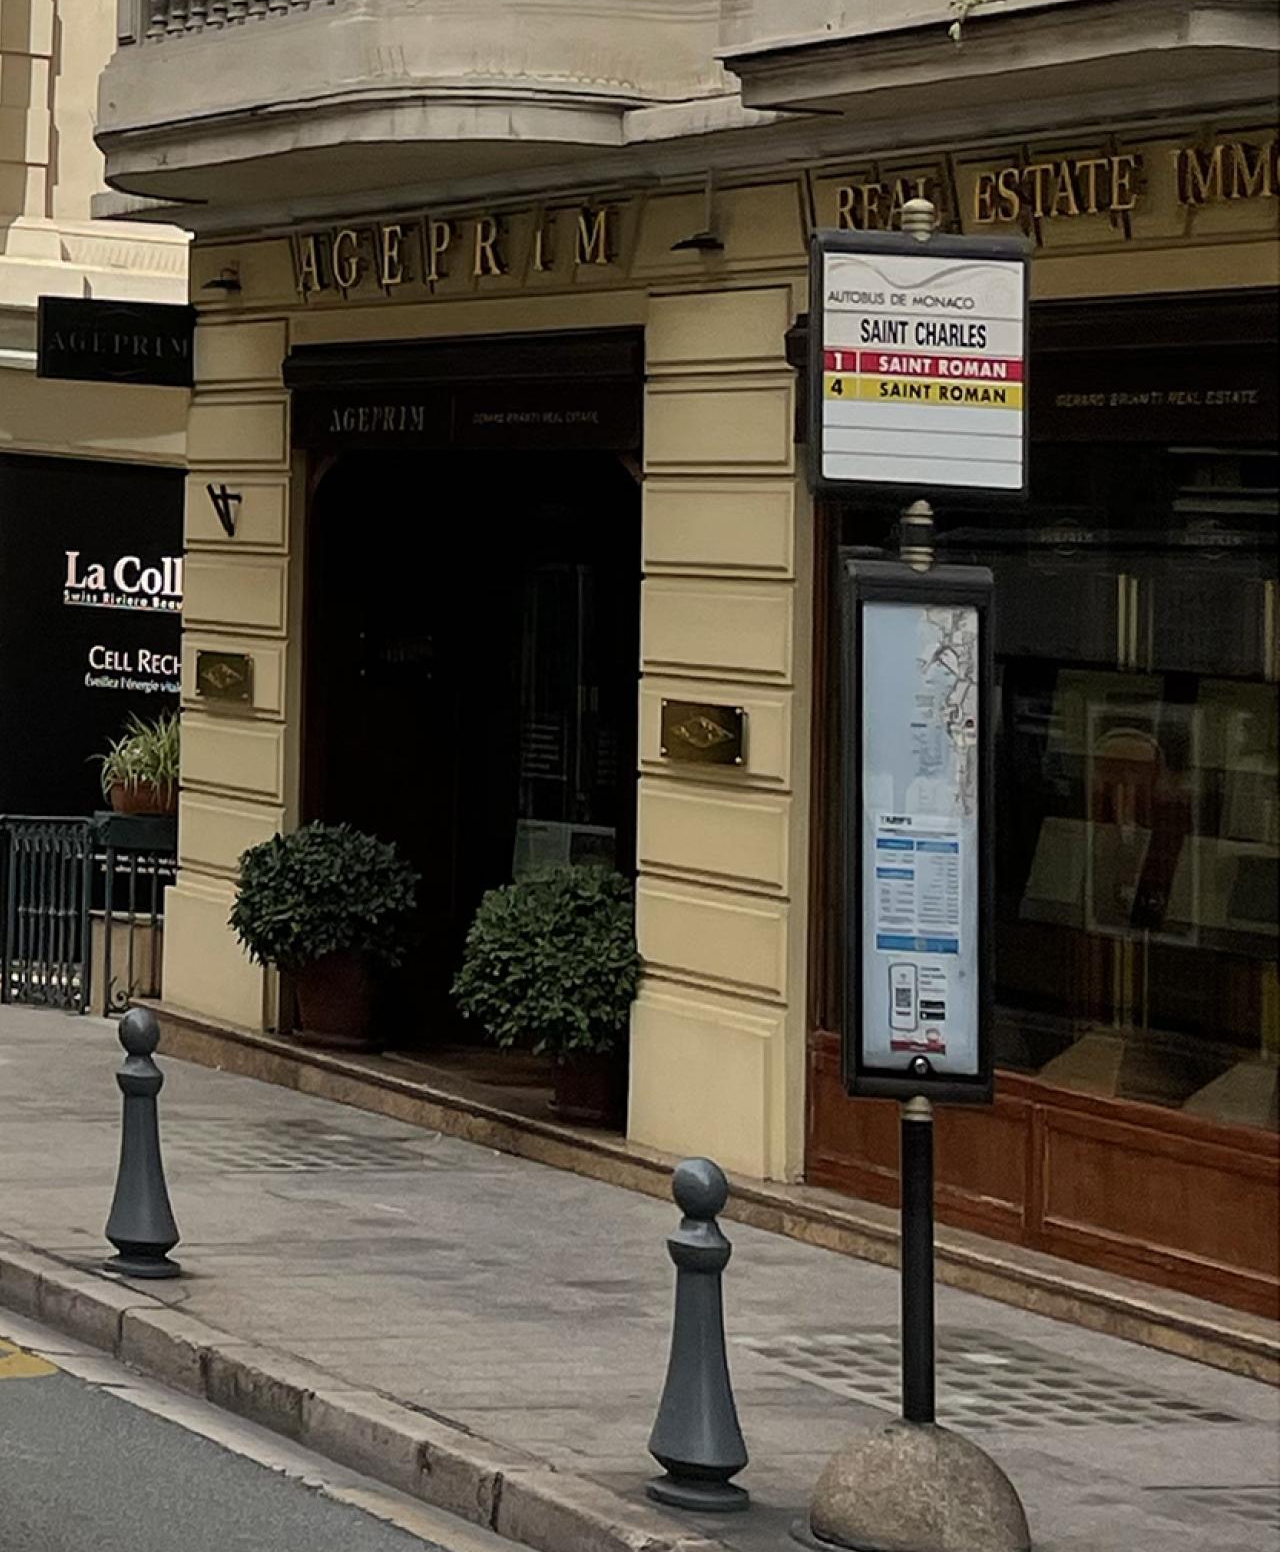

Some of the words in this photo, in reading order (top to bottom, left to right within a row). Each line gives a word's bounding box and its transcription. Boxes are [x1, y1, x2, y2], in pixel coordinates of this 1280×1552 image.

[973, 154, 1138, 224] ESTATE
[1169, 142, 1280, 204] IMM
[295, 209, 609, 294] AGEPRIM
[827, 290, 886, 305] AUTOBUS
[890, 293, 908, 307] DE
[912, 294, 976, 311] MONACO
[860, 318, 909, 345] SAINT
[915, 322, 987, 349] CHARLES
[834, 352, 843, 371] 1
[878, 356, 932, 376] SAINT
[938, 360, 1007, 379] ROMAN
[831, 378, 843, 397] 4
[880, 382, 932, 400] SAINT
[938, 385, 1007, 404] ROMAN
[329, 405, 426, 434] AGEPRIM
[64, 550, 107, 590] La
[113, 555, 184, 596] Coll
[88, 645, 134, 672] CELL
